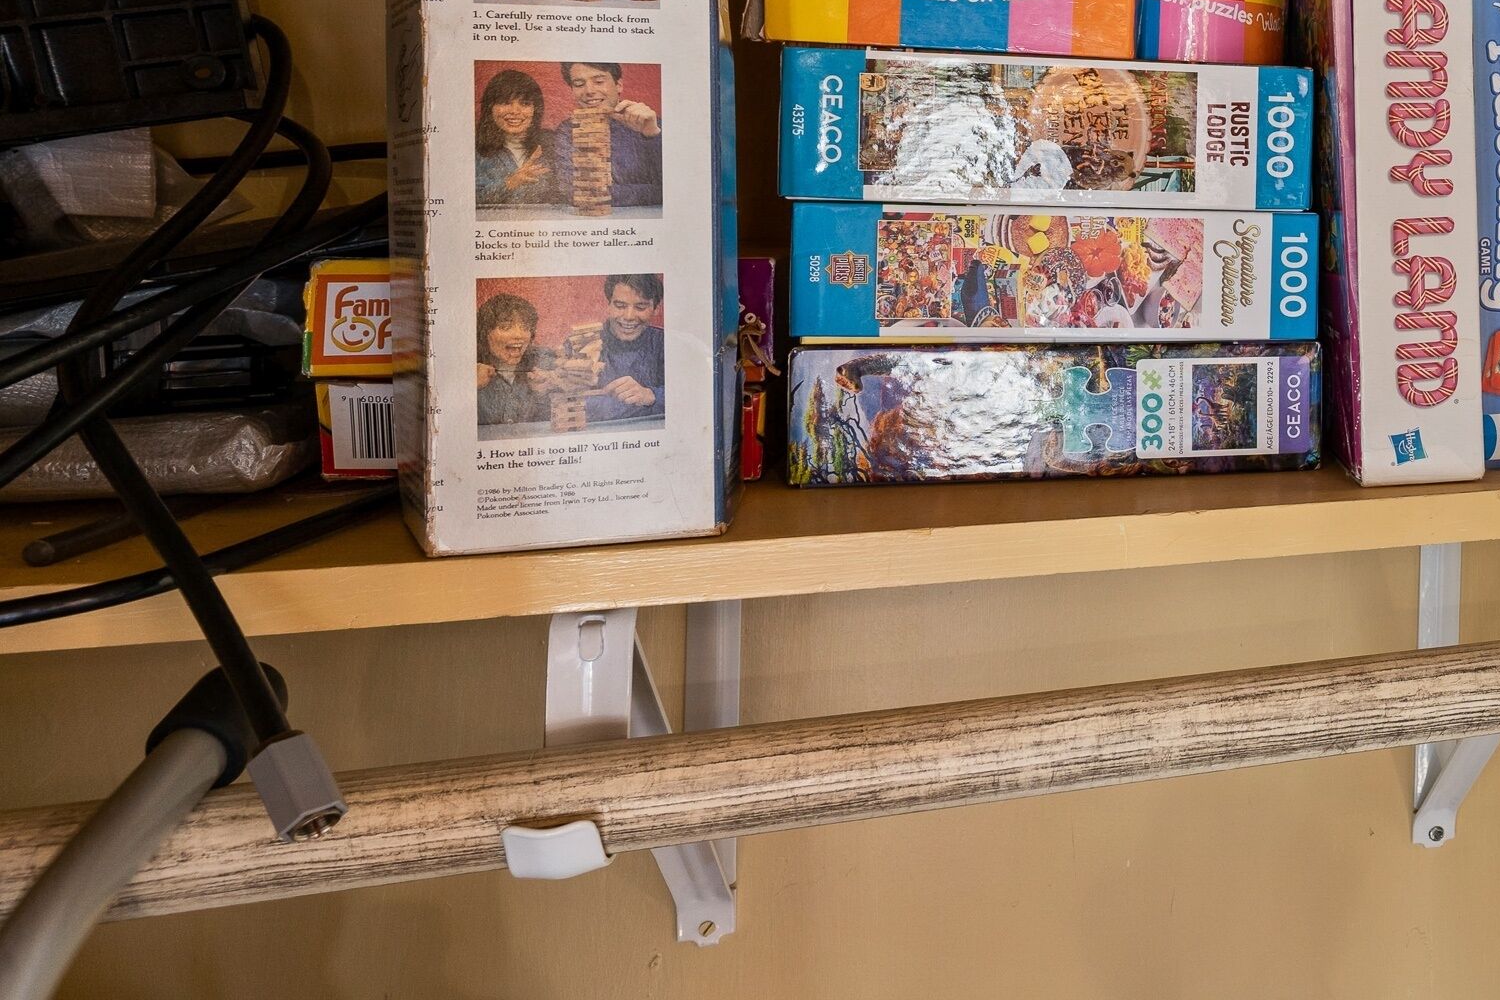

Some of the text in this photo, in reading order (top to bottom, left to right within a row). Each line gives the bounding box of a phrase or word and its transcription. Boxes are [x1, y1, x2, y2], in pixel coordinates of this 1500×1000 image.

[473, 10, 650, 25] 1. Carefully remove one block from
[791, 103, 804, 135] 43375
[819, 74, 843, 163] CEACO
[1205, 103, 1227, 163] LODGE
[1266, 91, 1295, 178] 1000
[808, 254, 820, 282] 50298
[834, 257, 850, 281] PIECES
[852, 258, 864, 281] MASTER
[1212, 239, 1240, 327] Collection
[1232, 218, 1261, 307] Signature
[1279, 232, 1308, 317] 1000
[1480, 238, 1491, 275] GAME
[335, 286, 390, 319] Fam
[1392, 216, 1458, 407] LAND
[1140, 392, 1163, 450] 300
[1286, 373, 1301, 438] CEACO
